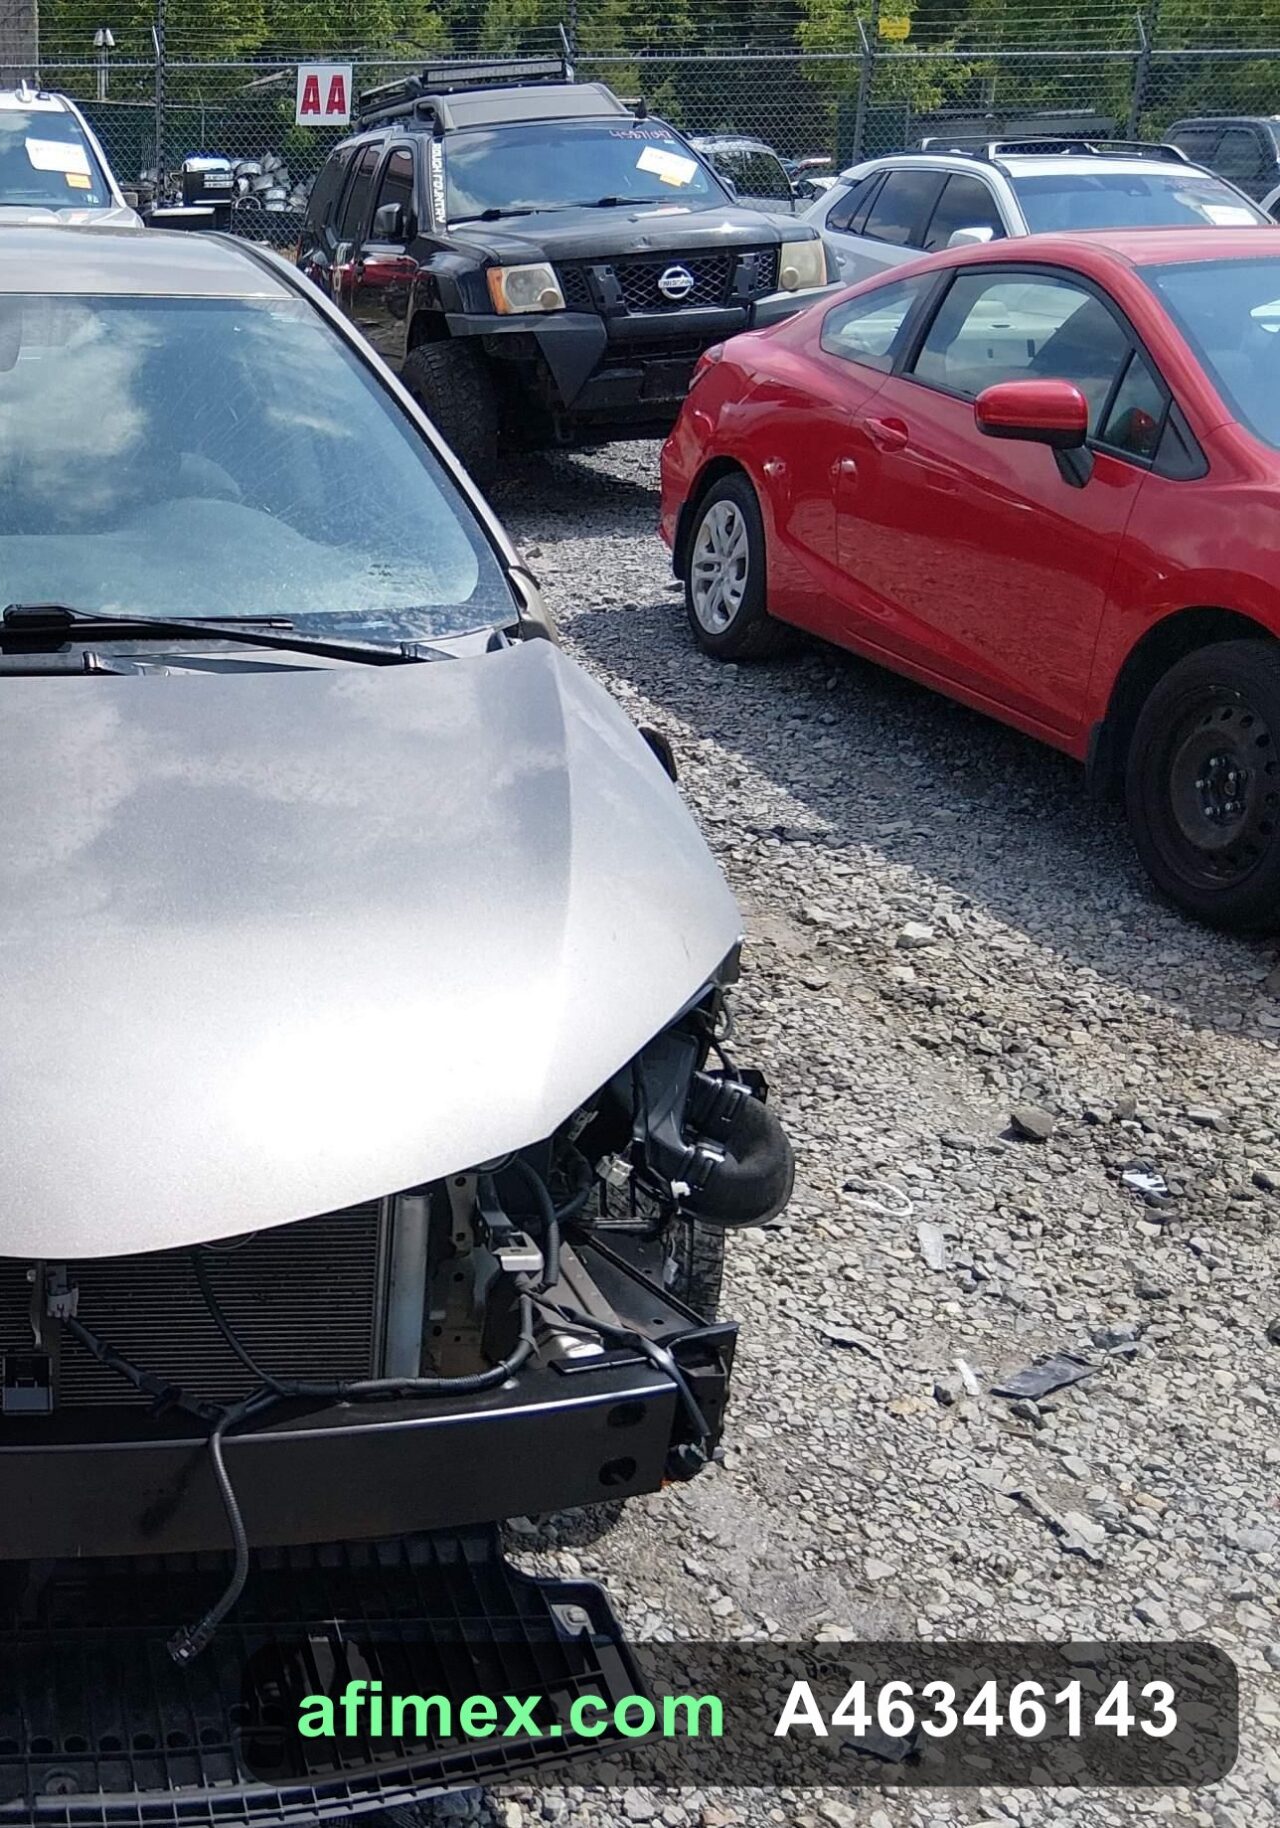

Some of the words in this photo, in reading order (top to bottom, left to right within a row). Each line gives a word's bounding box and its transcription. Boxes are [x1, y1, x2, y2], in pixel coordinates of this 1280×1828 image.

[300, 75, 346, 114] AA
[431, 143, 443, 173] ROUGH
[433, 174, 446, 223] COUNTRY
[661, 278, 692, 287] NISSAN
